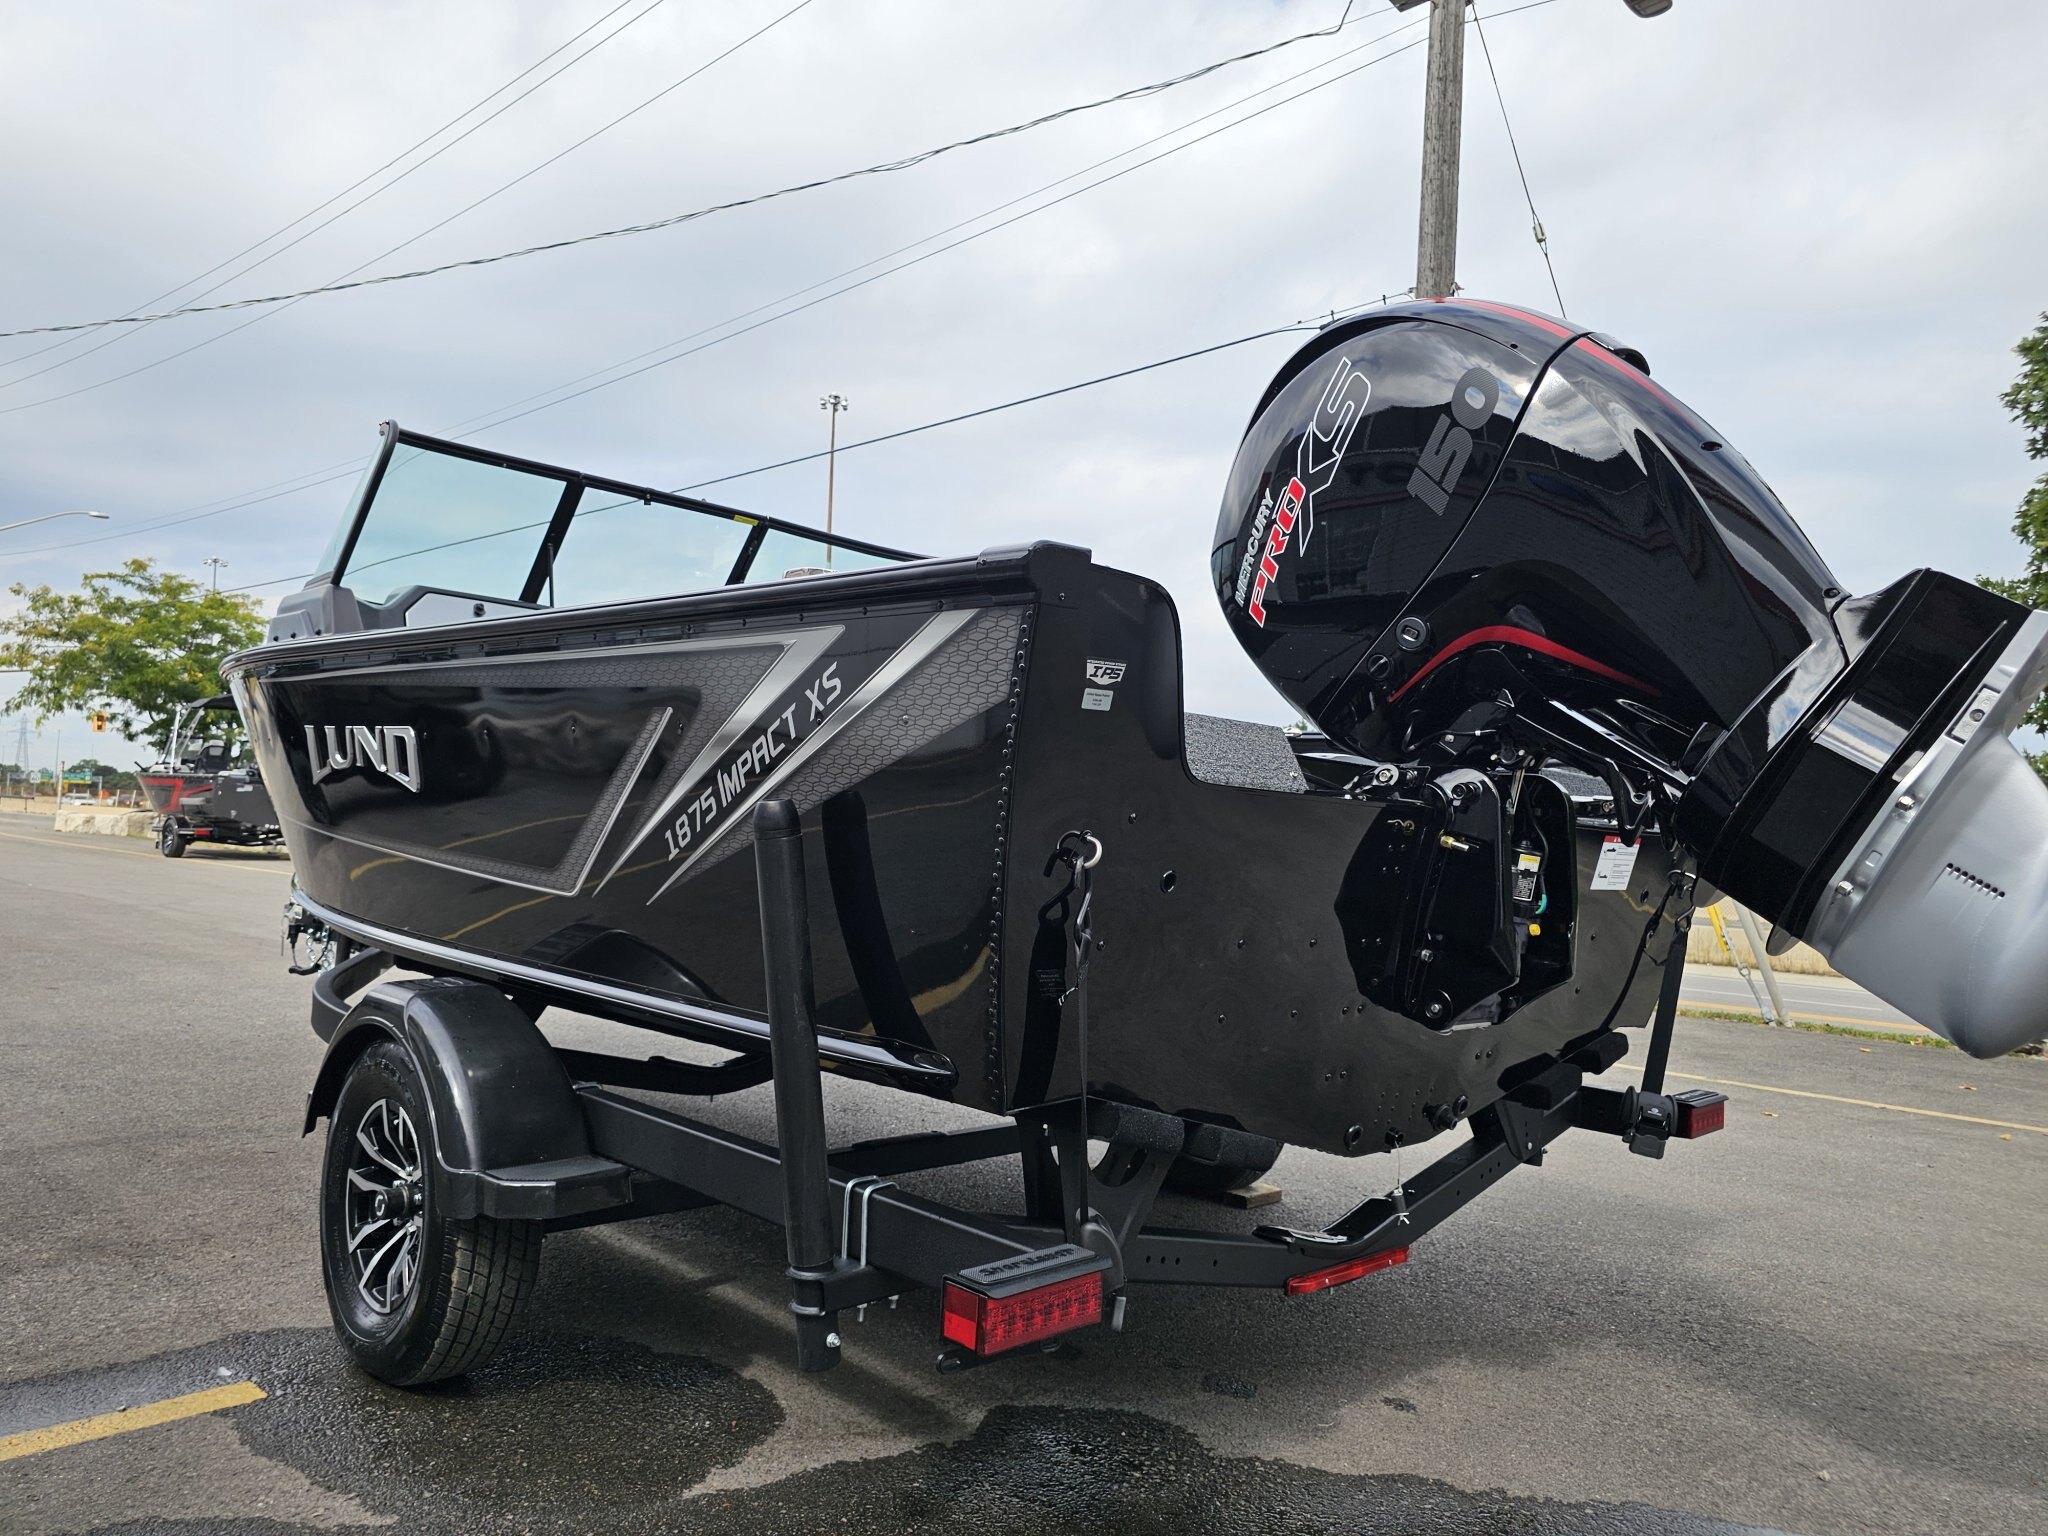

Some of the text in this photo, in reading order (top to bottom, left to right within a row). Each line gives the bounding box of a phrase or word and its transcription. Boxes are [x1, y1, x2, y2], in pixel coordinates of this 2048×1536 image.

[1249, 356, 1371, 629] PRO XS
[1406, 367, 1500, 516] 150
[1234, 487, 1274, 608] MERCURY
[1089, 665, 1123, 680] IPS
[304, 725, 420, 793] LUND
[664, 661, 842, 861] 1875 IMPACT XS
